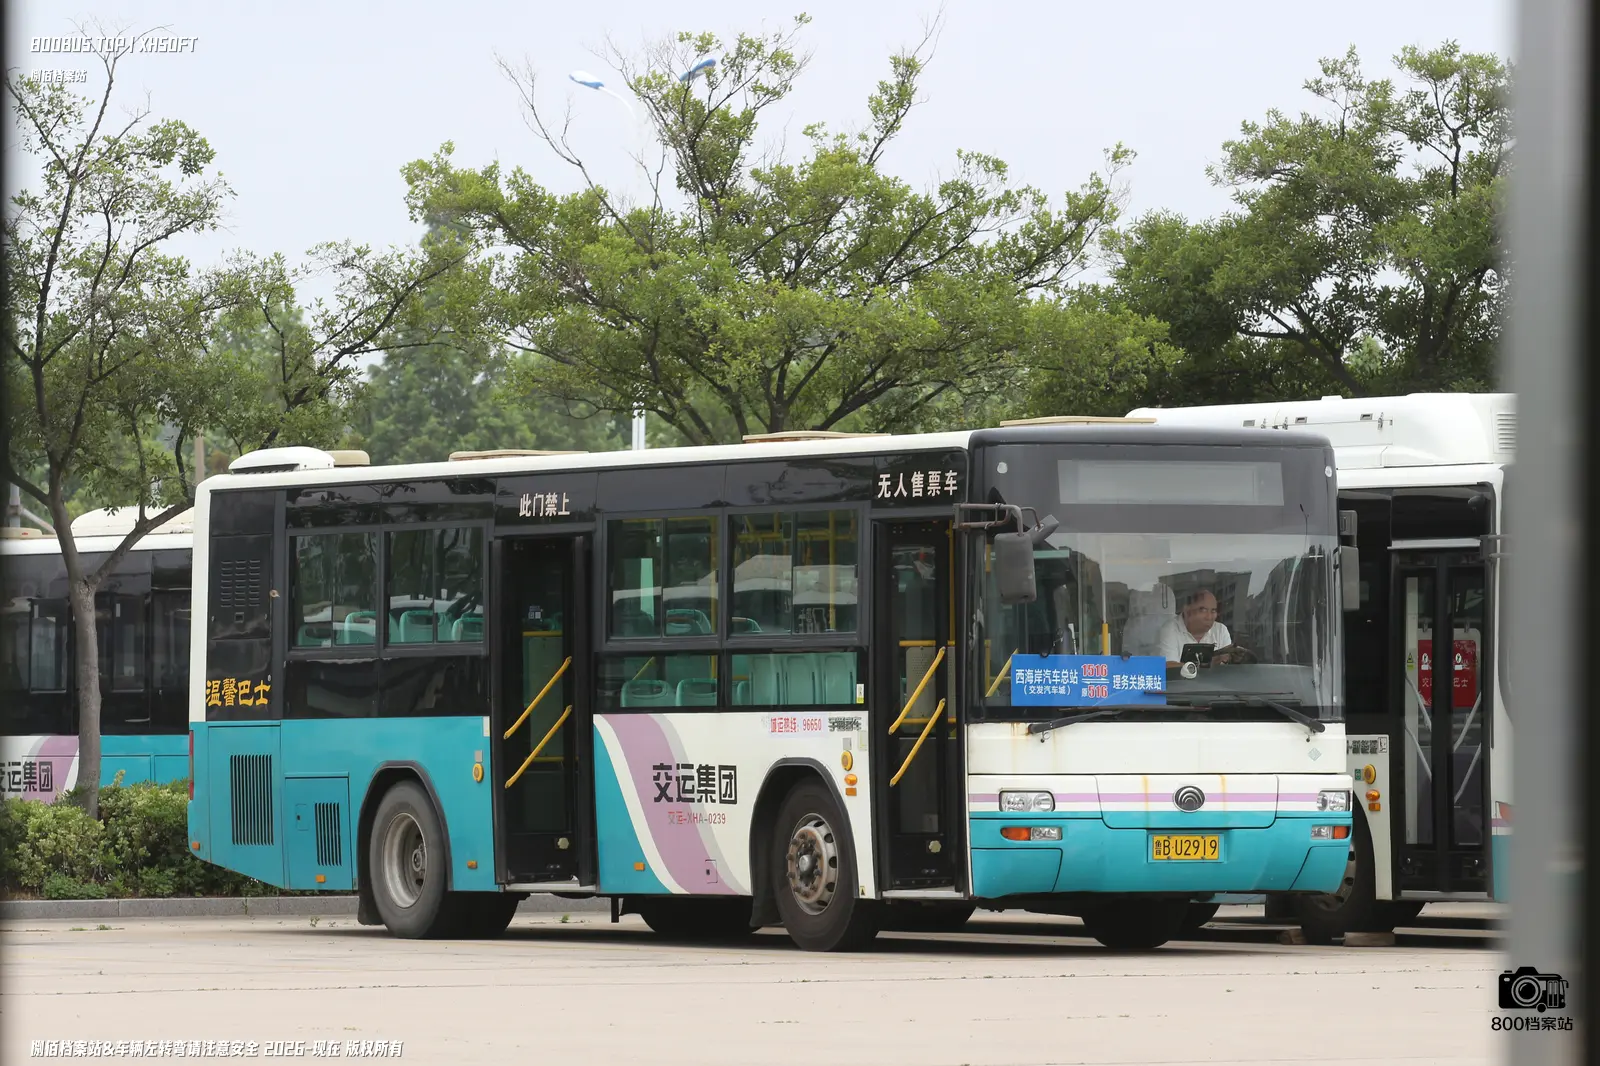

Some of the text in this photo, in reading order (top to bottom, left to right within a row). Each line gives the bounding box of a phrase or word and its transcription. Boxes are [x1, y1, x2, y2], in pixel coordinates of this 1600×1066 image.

[877, 469, 958, 499] 无人售票车
[519, 492, 570, 517] 此门禁上
[1015, 668, 1079, 685] 西海岸汽车总站
[1081, 663, 1108, 678] 1516
[206, 677, 271, 707] 温馨巴士
[1112, 674, 1162, 691] 理务关换乘站
[802, 718, 822, 731] 96650
[652, 763, 738, 805] 交运集团
